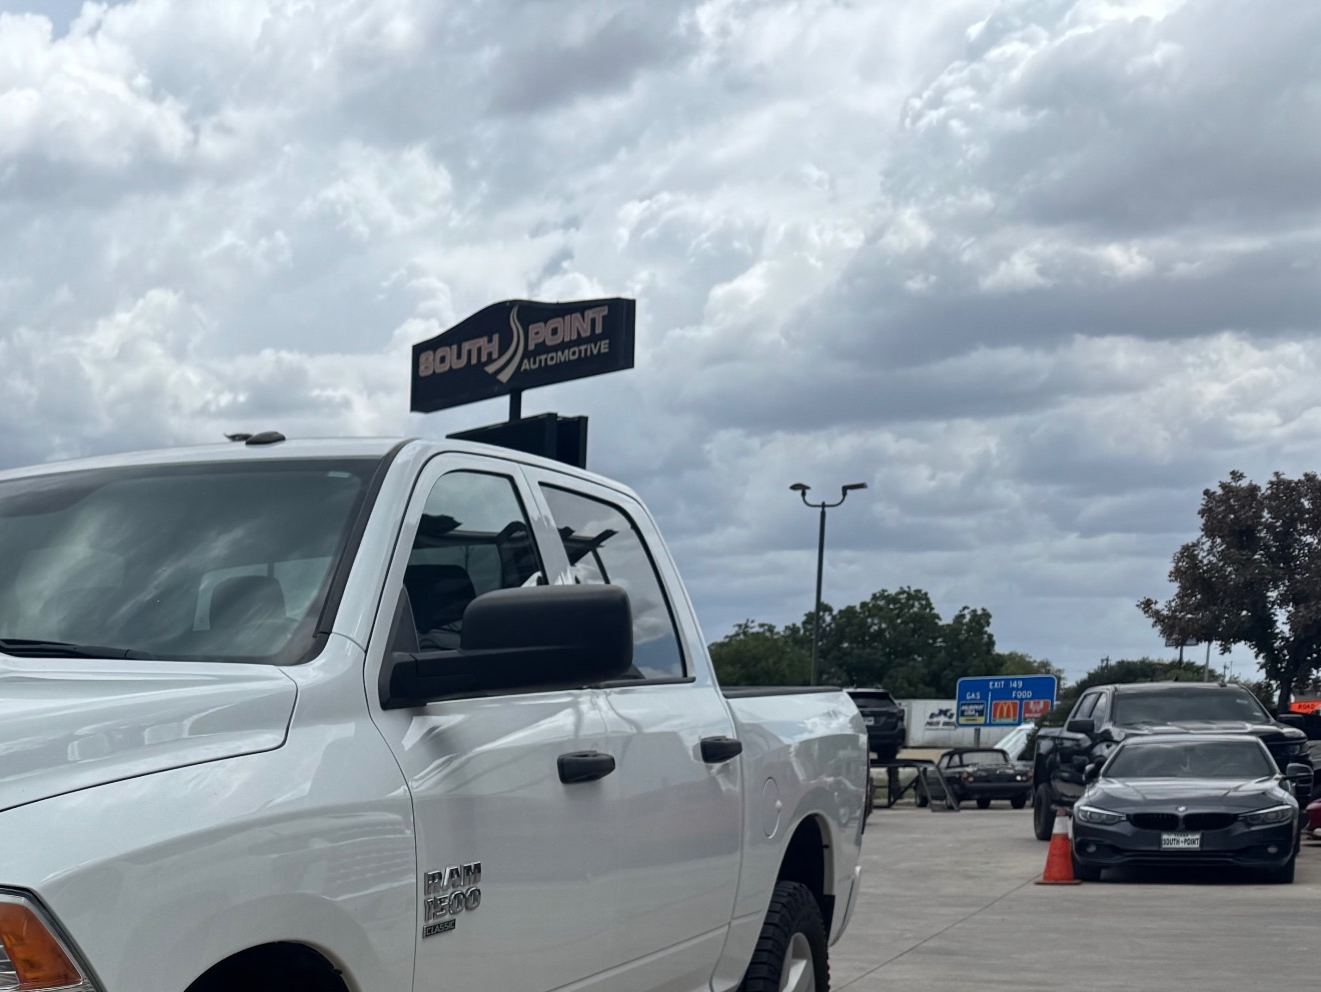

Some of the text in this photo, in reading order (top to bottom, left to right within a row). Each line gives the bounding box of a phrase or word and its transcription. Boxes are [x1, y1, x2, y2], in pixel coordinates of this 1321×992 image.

[418, 305, 609, 377] SOUTH POINT
[520, 339, 610, 372] AUTOMOTIVE
[966, 691, 981, 699] GAS
[989, 680, 1023, 689] EXIT 149
[1012, 690, 1032, 698] FOOD
[424, 861, 482, 896] RAM
[424, 887, 482, 923] 1500
